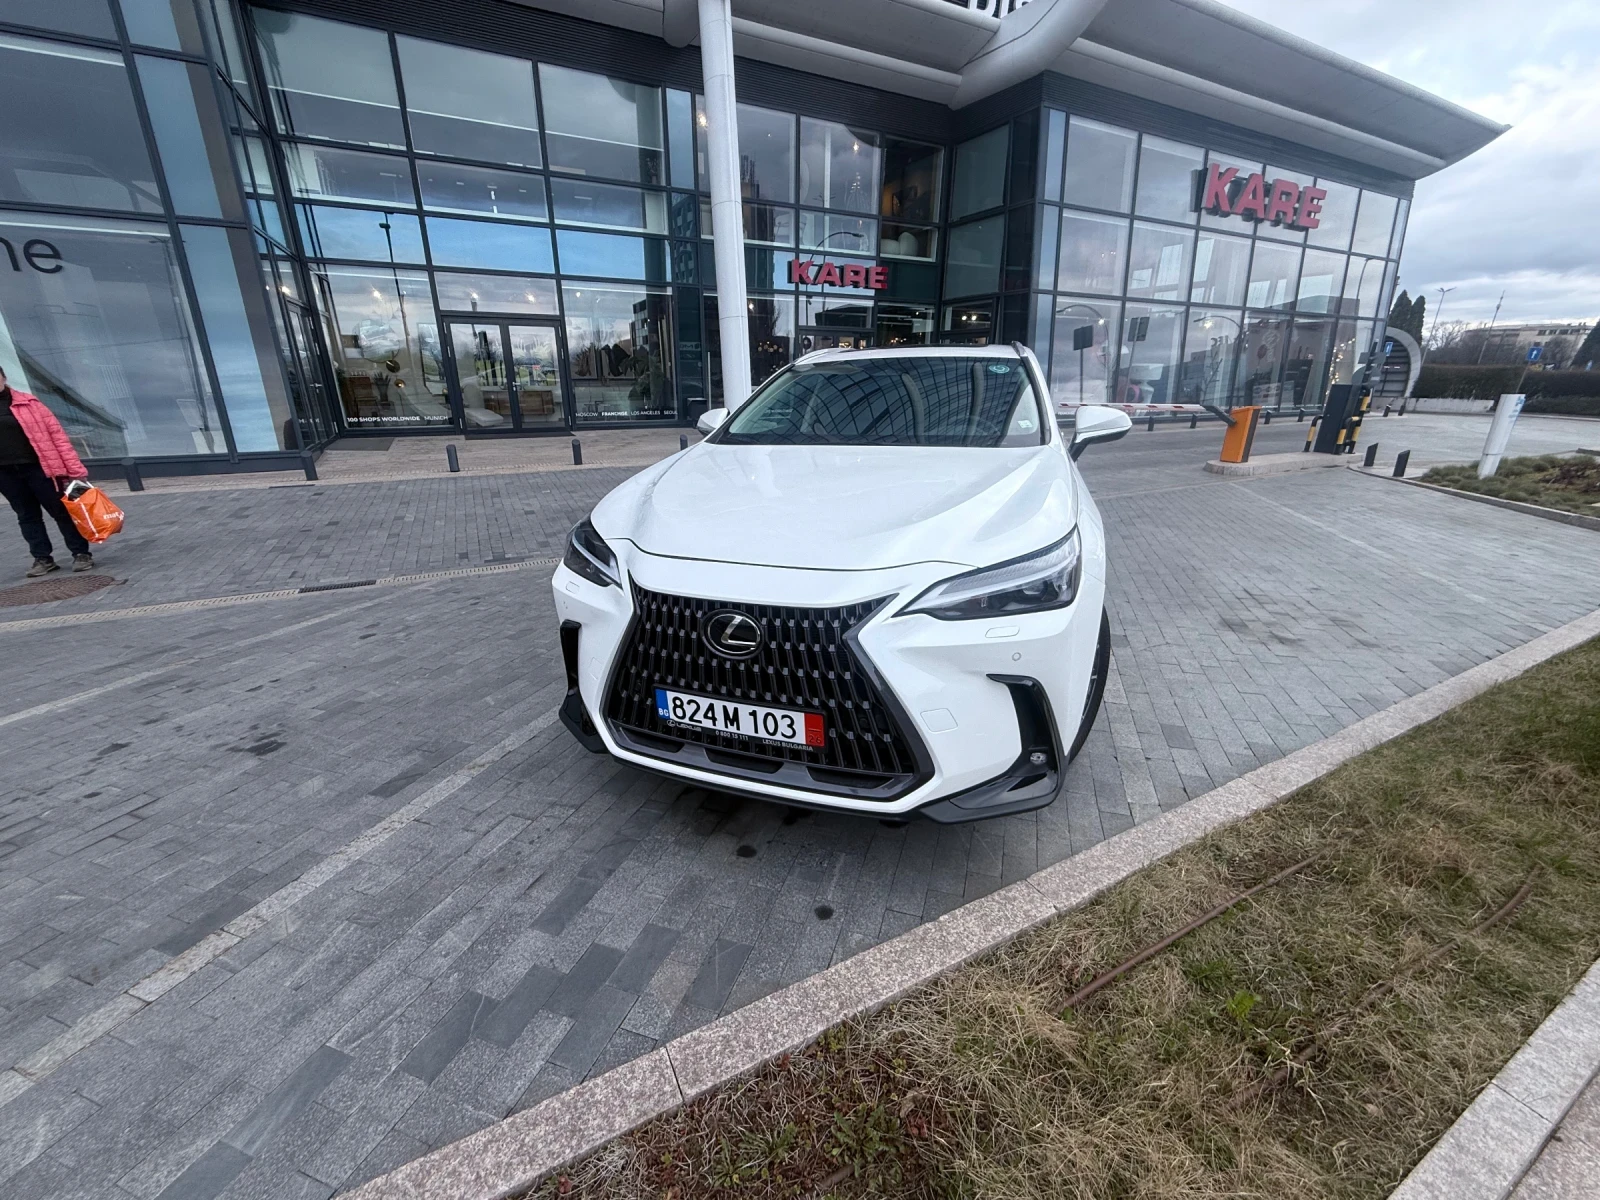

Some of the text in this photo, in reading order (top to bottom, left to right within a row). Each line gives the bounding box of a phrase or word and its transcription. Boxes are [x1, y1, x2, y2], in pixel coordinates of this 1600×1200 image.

[1201, 162, 1327, 229] KARE
[790, 259, 889, 290] KARE
[658, 707, 670, 717] BG
[672, 696, 797, 739] 824 M 103
[762, 739, 814, 751] LEXUS BULGARIA
